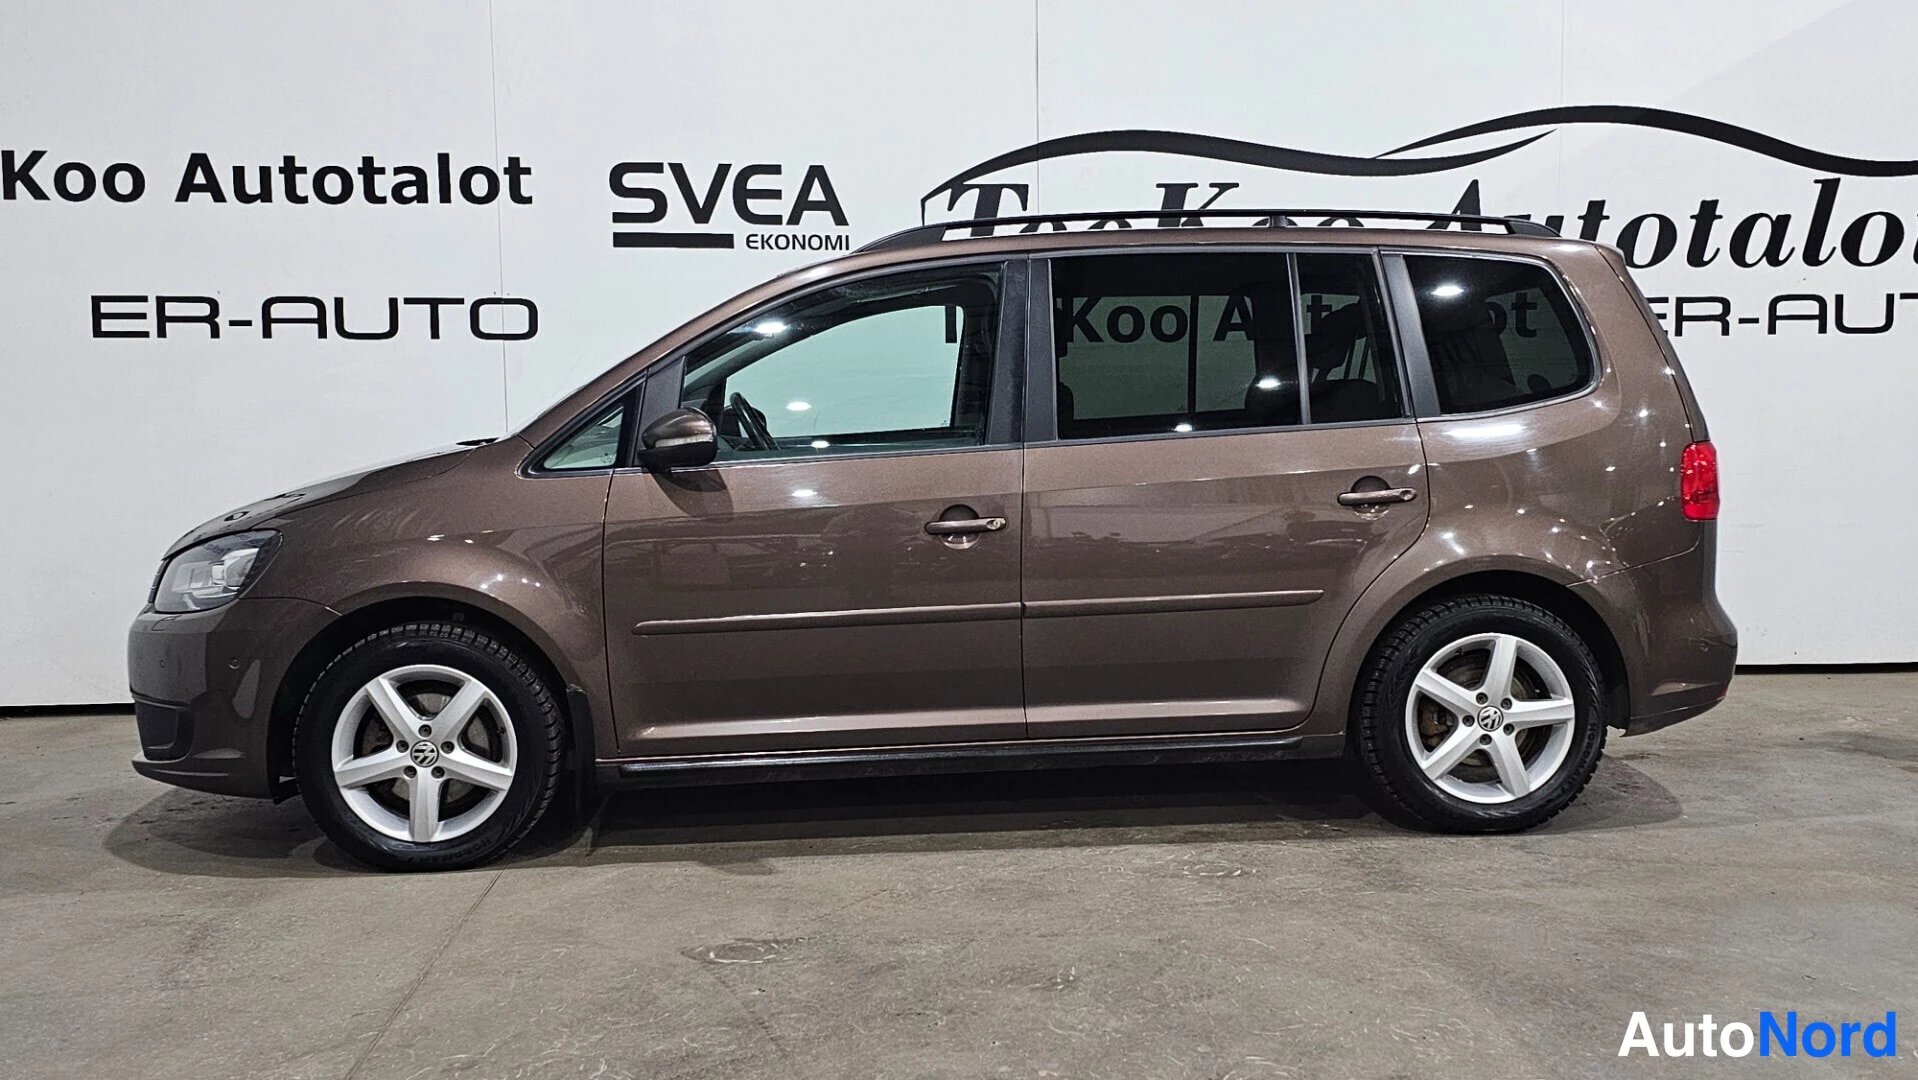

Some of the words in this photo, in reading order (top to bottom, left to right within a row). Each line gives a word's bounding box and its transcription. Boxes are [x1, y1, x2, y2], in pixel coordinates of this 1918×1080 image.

[1, 149, 146, 202] Koo
[174, 152, 533, 205] Autotalot
[608, 162, 850, 226] SVEA
[745, 233, 850, 251] EKONOMI
[1426, 177, 1918, 269] Atotalo
[90, 294, 539, 341] ER-AUTO
